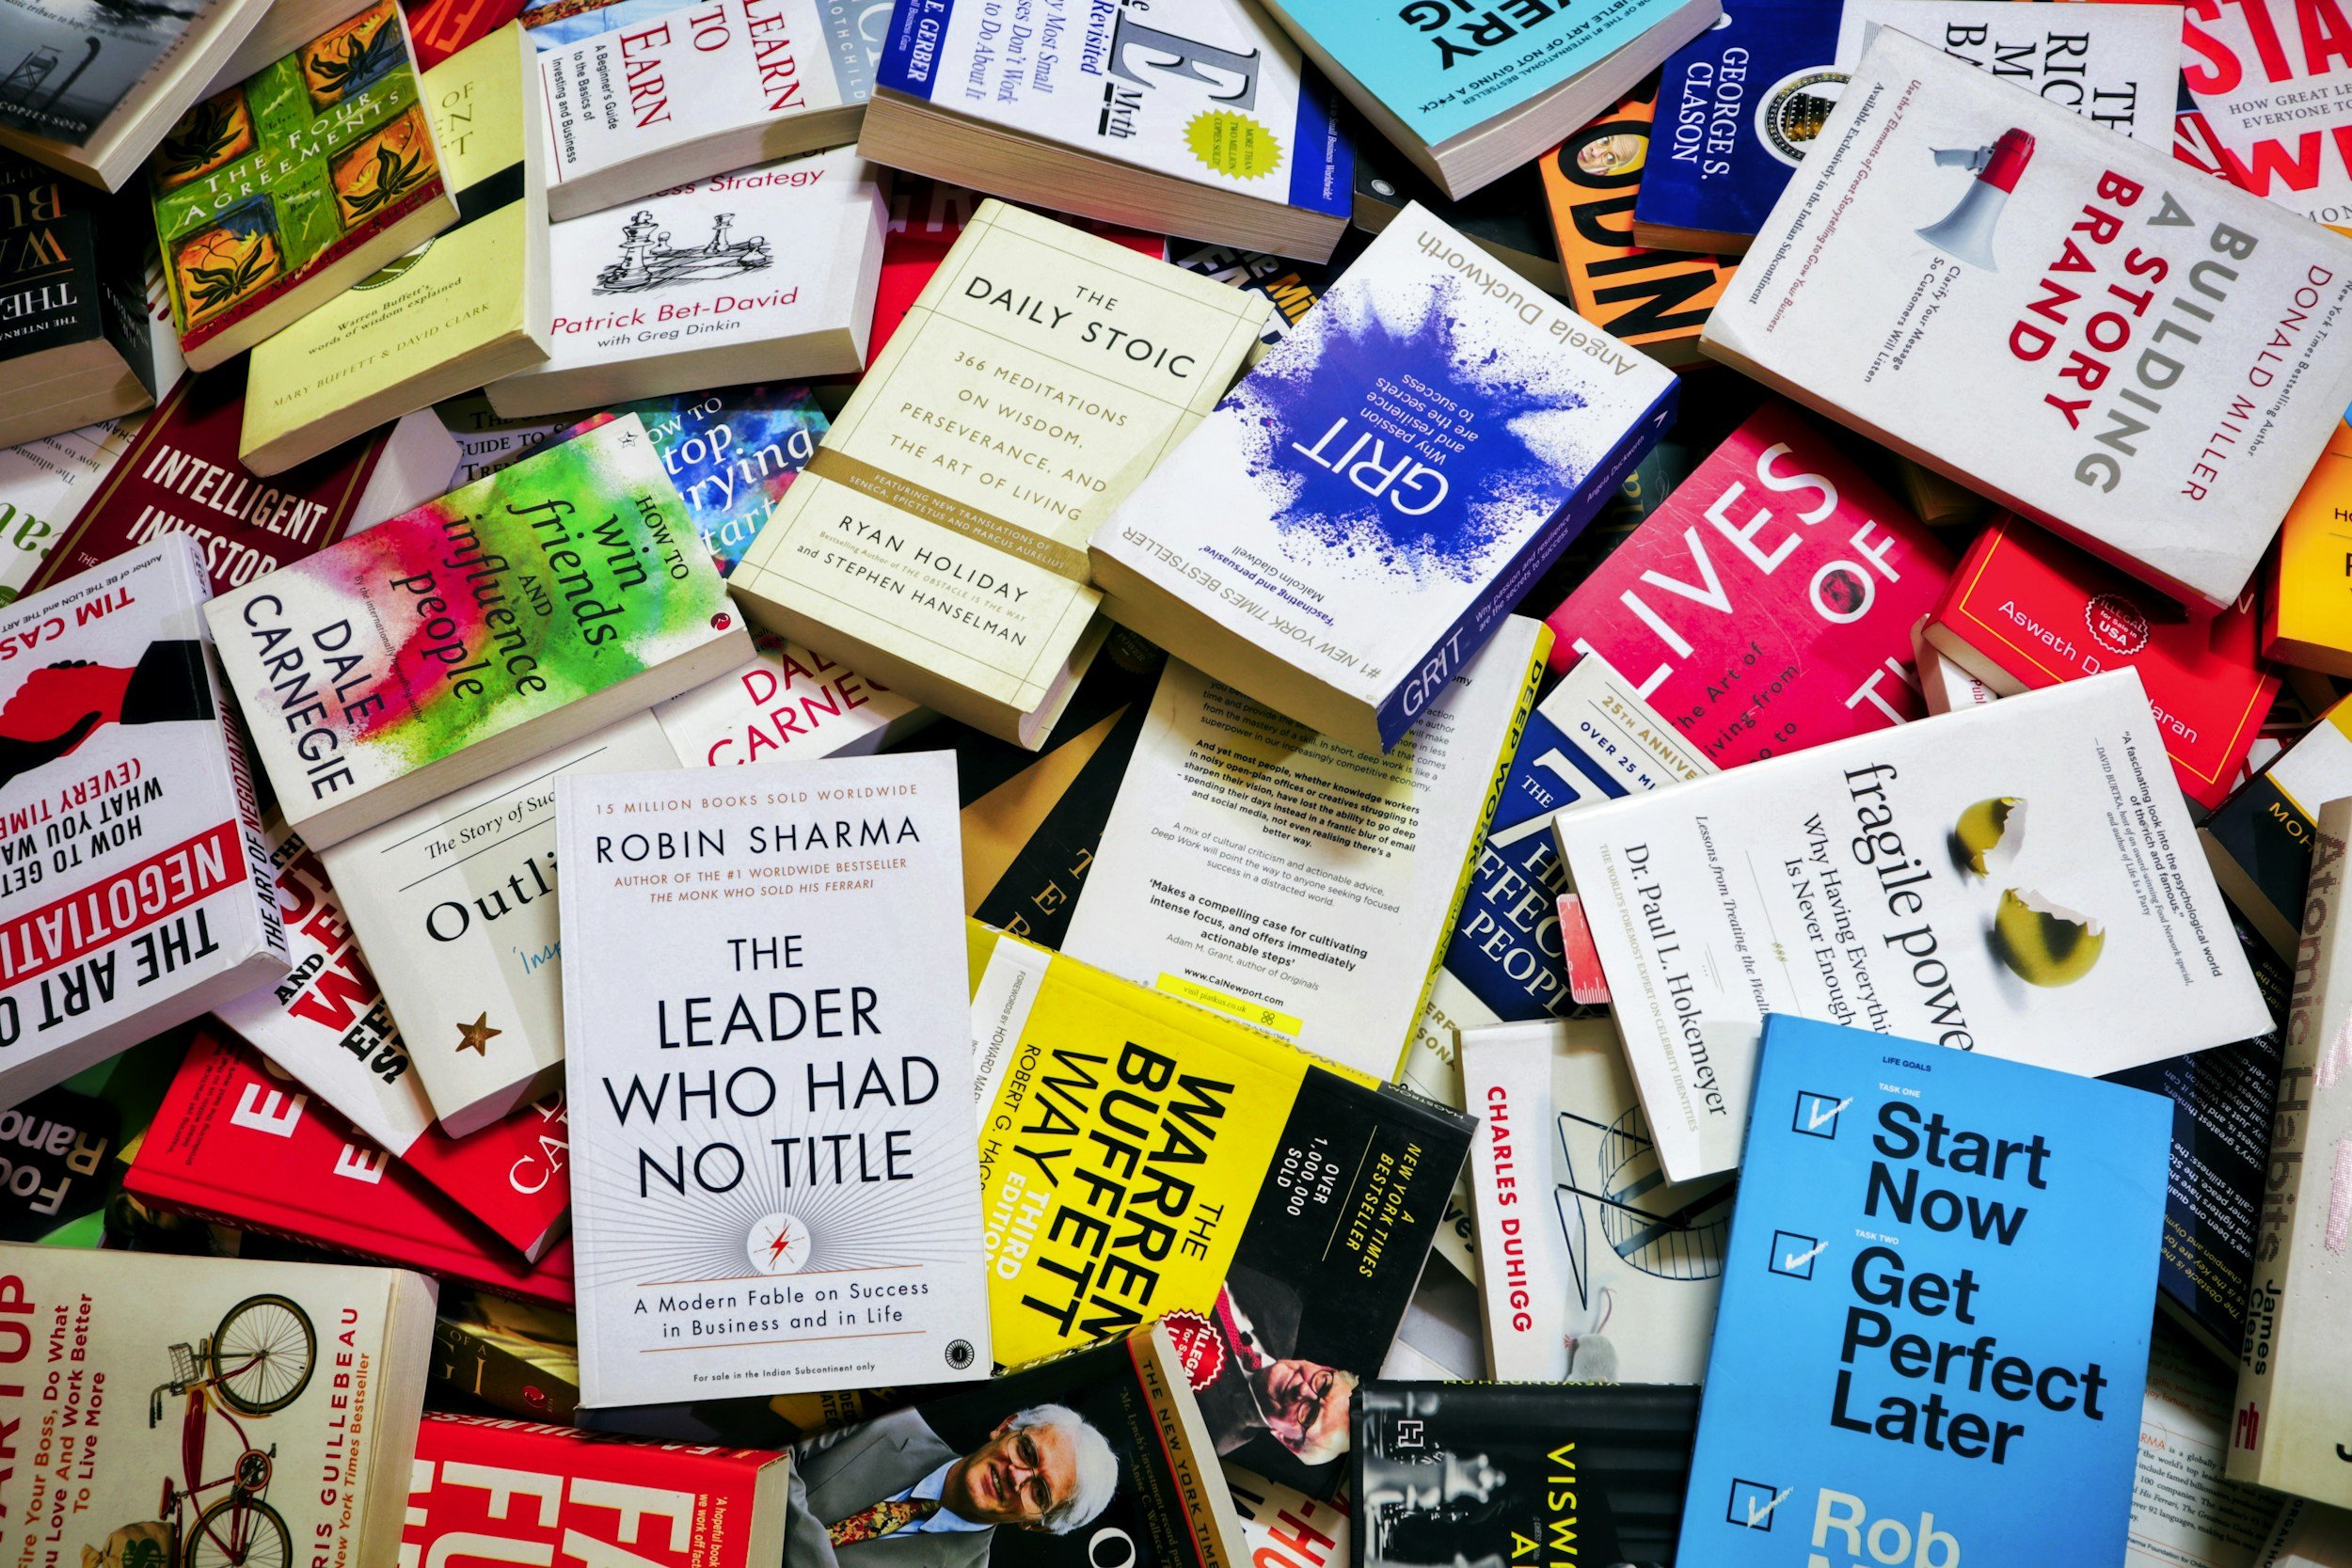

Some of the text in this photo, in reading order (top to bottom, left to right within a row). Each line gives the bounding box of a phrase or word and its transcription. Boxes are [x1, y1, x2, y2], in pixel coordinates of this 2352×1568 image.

[619, 28, 672, 128] EARN
[690, 17, 729, 53] TO
[907, 18, 940, 81] GERBER
[204, 92, 373, 193] THE FOUR
[552, 57, 577, 164] Investing and Business
[1107, 85, 1143, 138] Myth
[1671, 61, 1714, 164] CLASON
[1701, 47, 1750, 180] GEORGE S.
[2229, 87, 2328, 115] HOW GREAT
[2242, 103, 2331, 129] EVERYONE
[183, 90, 400, 226] AGREEMENTS
[2146, 190, 2195, 228] A
[1075, 285, 1118, 311] THE
[1417, 230, 1638, 376] Angela Duckworth
[2009, 170, 2144, 362] BRAND
[273, 388, 310, 408] MARY
[317, 356, 377, 389] BUFFETT
[397, 325, 440, 352] DAVID
[445, 302, 490, 329] CLARK
[550, 286, 799, 336] Patrick Bet-David
[597, 319, 740, 348] with Greg Dinkin
[964, 276, 1196, 378] DAILY STOIC
[1892, 265, 1961, 371] Clarify Your Message
[2044, 248, 2168, 430] STORY
[954, 351, 1128, 427] 366 MEDITATIONS
[2074, 222, 2259, 494] BUILDING
[2181, 264, 2333, 501] DONALD MILLER
[1294, 419, 1449, 515] GRIT
[1359, 407, 1447, 466] Why passion
[141, 444, 328, 545] INTELLIGENT
[635, 495, 690, 580] HOW TO
[874, 474, 1051, 550] FEATURING NEW TRANSLATIONS OF
[85, 582, 104, 595] THE
[105, 575, 119, 586] BE
[119, 570, 130, 580] of
[132, 554, 162, 573] Author
[506, 499, 625, 646] friends
[518, 575, 553, 617] AND
[592, 514, 647, 591] win
[797, 546, 1026, 646] and STEPHEN HANSELMAN
[838, 515, 1028, 603] RYAN HOLIDAY
[1571, 442, 1839, 701] LIVES
[1809, 520, 1900, 624] OF
[23, 610, 41, 625] THE
[42, 602, 60, 615] and
[61, 591, 84, 607] LION
[75, 586, 135, 627] TIM
[390, 569, 485, 700] people
[444, 513, 548, 697] influence
[1121, 526, 1382, 679] #1 NEW YORK TIMES BESTSELLER
[1998, 600, 2076, 661] Aswath
[2098, 621, 2127, 646] USA
[243, 594, 354, 800] CARNEGIE
[312, 618, 386, 724] DALE
[1402, 627, 1465, 719] GRIT
[596, 784, 917, 815] 15 MILLION BOOKS SOLD WORLDWIDE
[596, 816, 920, 863] ROBIN SHARMA
[1845, 762, 1932, 917] fragile
[2129, 795, 2185, 918] of the rich and famous.”
[38, 908, 220, 1032] THE ART
[727, 935, 803, 972] THE
[1150, 895, 1357, 973] intense focus, and offers immediately
[659, 987, 882, 1050] LEADER
[1184, 968, 1284, 1006] www.CalNewport.com
[1624, 843, 1727, 1116] Dr. Paul L. Hokemeyer
[602, 1056, 940, 1127] WHO HAD
[991, 1044, 1041, 1132] ROBERT G.
[1882, 1055, 1931, 1072] LIFE GOALS
[1013, 1049, 1108, 1188] WAY
[1872, 1101, 2051, 1190] Start
[640, 1130, 914, 1197] NO TITLE
[1021, 1040, 1177, 1338] BUFFETT
[1079, 1074, 1235, 1339] WARREN
[1277, 1148, 1303, 1188] SOLD
[1286, 1137, 1328, 1216] 1,000,000
[1312, 1164, 1340, 1204] OVER
[1345, 1152, 1394, 1251] BESTSELLER
[1864, 1160, 2028, 1247] Now
[996, 1190, 1051, 1280] THIRD
[1181, 1204, 1224, 1261] THE
[1359, 1142, 1422, 1278] NEW YORK TIMES
[1487, 1085, 1533, 1332] CHARLES DUHIGG
[1851, 1246, 1979, 1324] Get
[2242, 1285, 2265, 1368] Clear
[2255, 1279, 2282, 1376] James
[320, 1308, 358, 1506] GUILLEBEAU
[693, 1373, 708, 1383] For
[711, 1371, 730, 1381] sale
[745, 1370, 759, 1379] the
[762, 1368, 791, 1377] Indian
[795, 1364, 853, 1375] Subcontinent
[856, 1361, 876, 1372] only
[1841, 1306, 2107, 1421] Perfect
[72, 1372, 105, 1513] To Live More
[1830, 1370, 2025, 1465] Later
